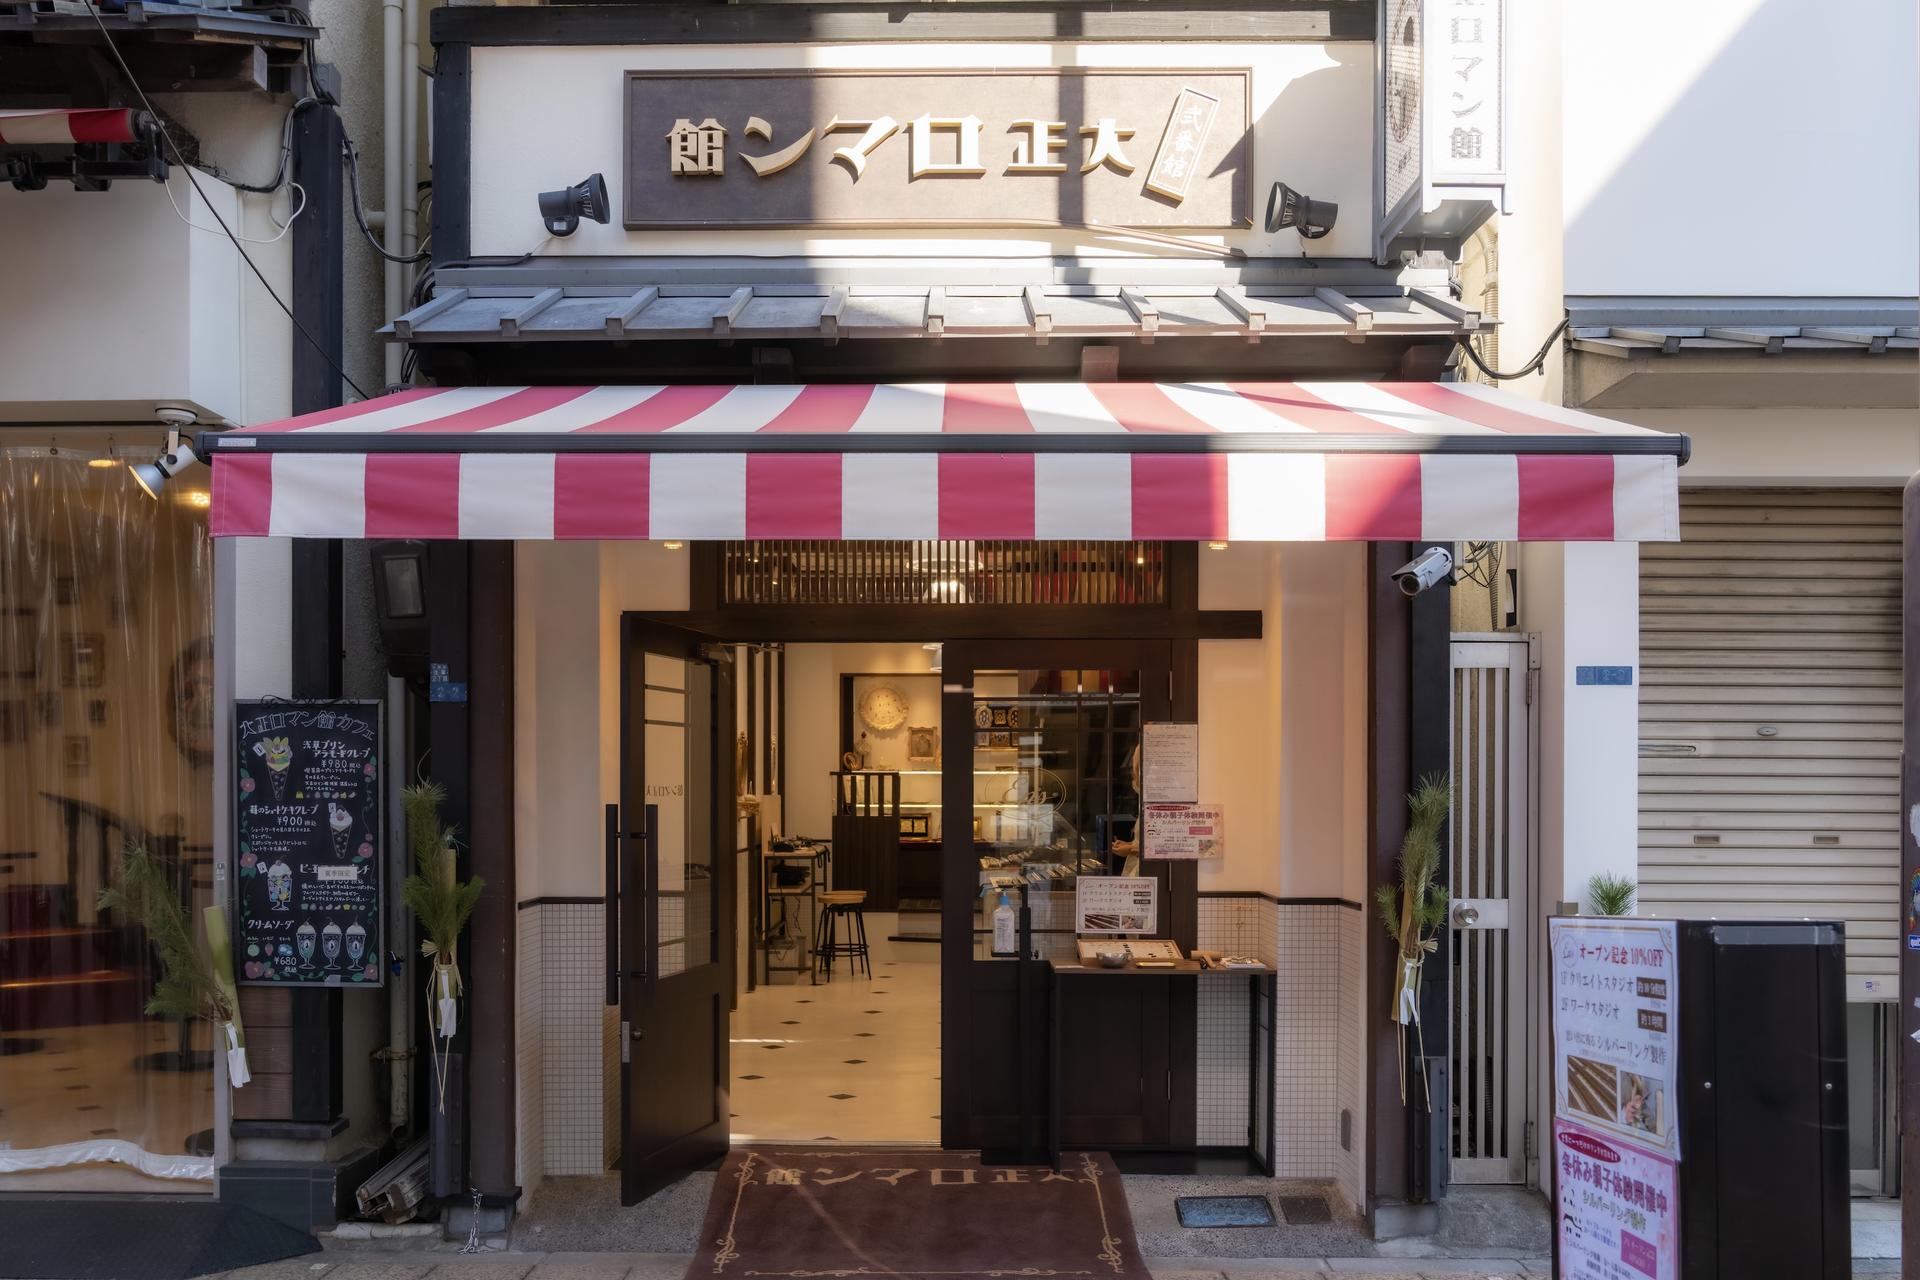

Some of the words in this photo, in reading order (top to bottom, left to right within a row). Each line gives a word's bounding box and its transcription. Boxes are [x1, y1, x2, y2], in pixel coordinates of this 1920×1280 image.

[1449, 0, 1484, 159] ロマン館
[665, 114, 1137, 183] 大正ロマン館
[239, 710, 375, 741] 大正ロマン館カフェ
[302, 740, 346, 750] 浅草プリン
[247, 919, 295, 930] クリームソーダ
[274, 956, 297, 966] ¥680
[1579, 944, 1628, 965] オープン記念
[1630, 948, 1664, 967] 10%OFF
[1569, 971, 1634, 993] クリエイトスタジオ
[1570, 998, 1620, 1020] ワークスタジオ
